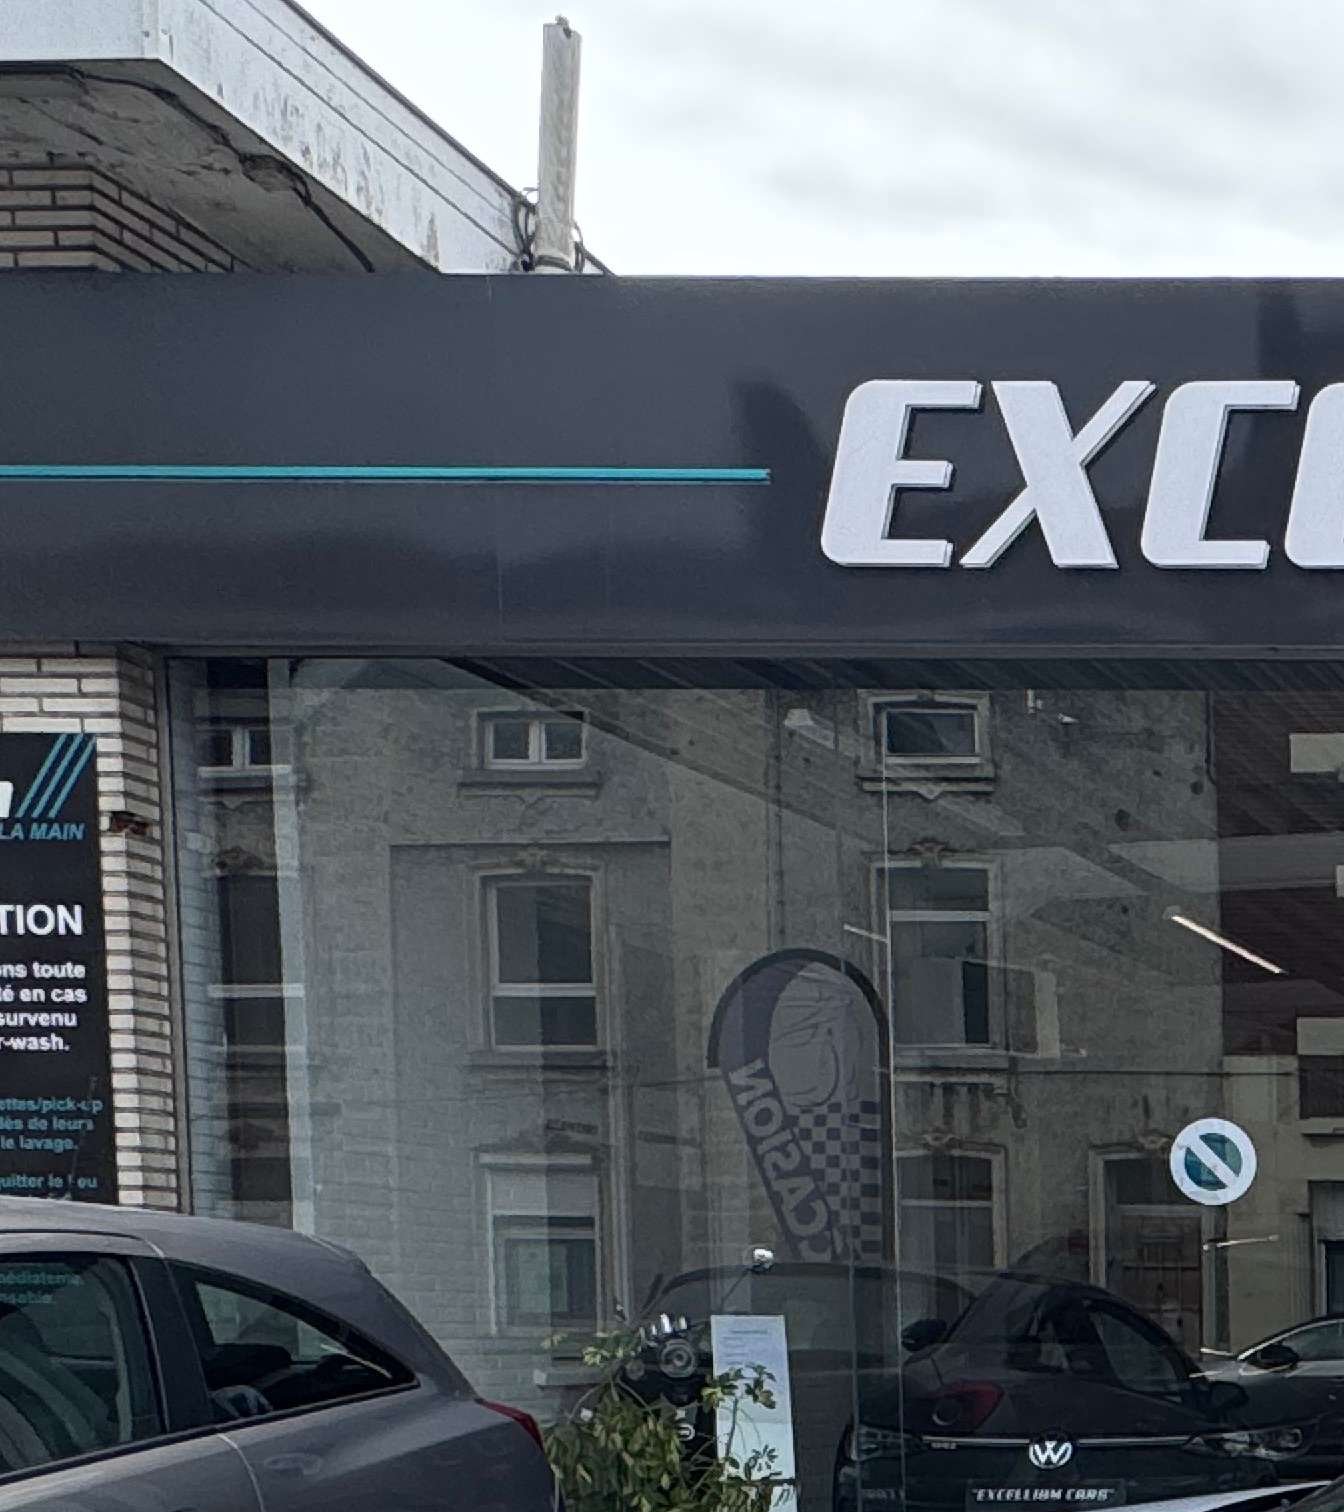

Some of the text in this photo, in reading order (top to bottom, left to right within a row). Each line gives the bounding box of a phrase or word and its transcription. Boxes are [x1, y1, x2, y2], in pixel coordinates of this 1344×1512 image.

[30, 822, 85, 841] MAIN
[32, 960, 86, 979] toute
[19, 988, 46, 1002] en
[50, 988, 88, 1003] cas
